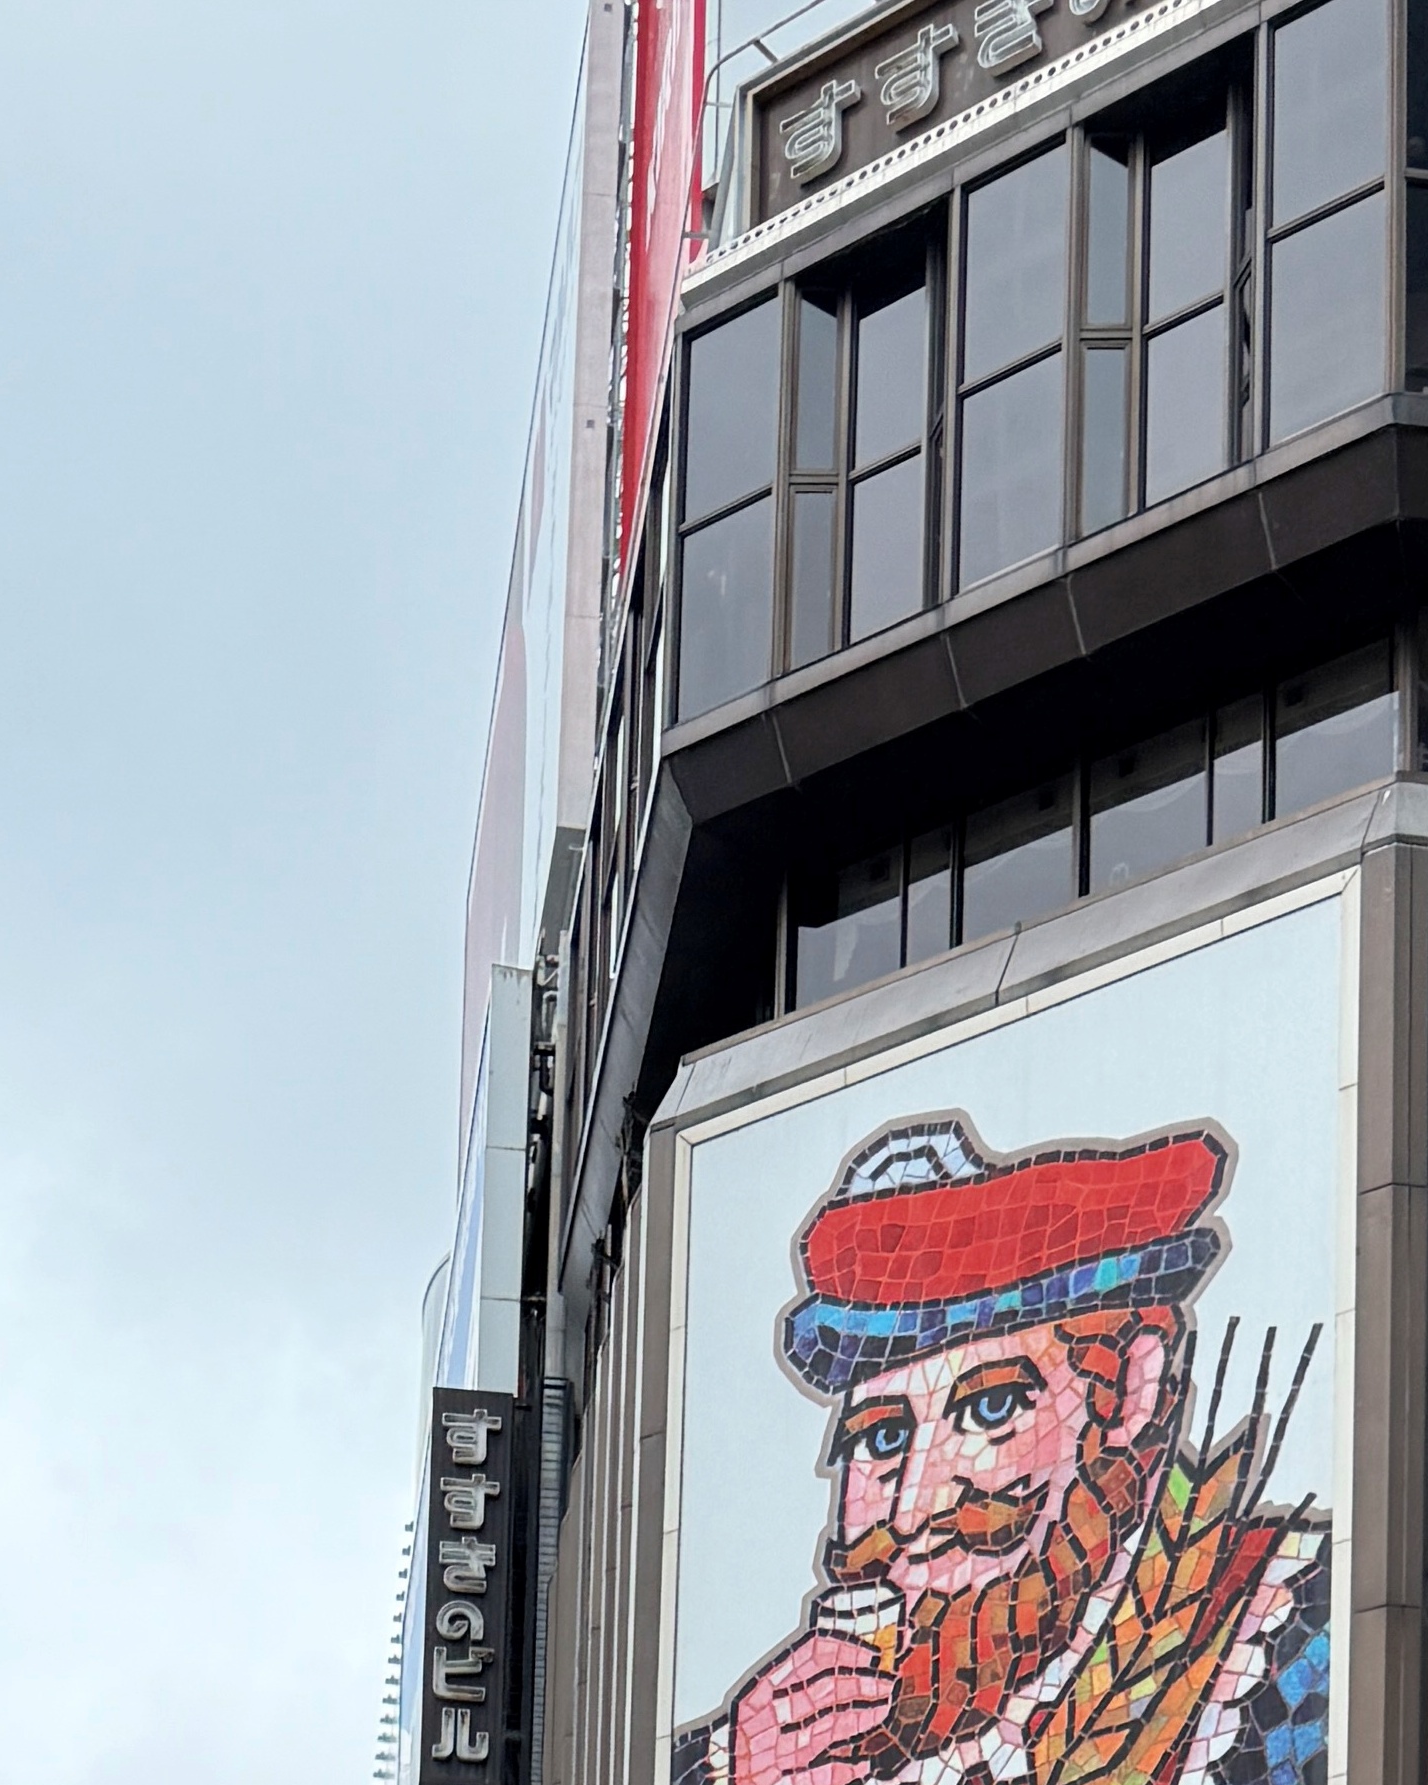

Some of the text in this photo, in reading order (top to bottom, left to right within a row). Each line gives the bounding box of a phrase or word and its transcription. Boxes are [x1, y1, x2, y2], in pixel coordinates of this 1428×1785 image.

[780, 0, 1106, 180] すすき
[432, 1408, 502, 1761] すすきのビル
